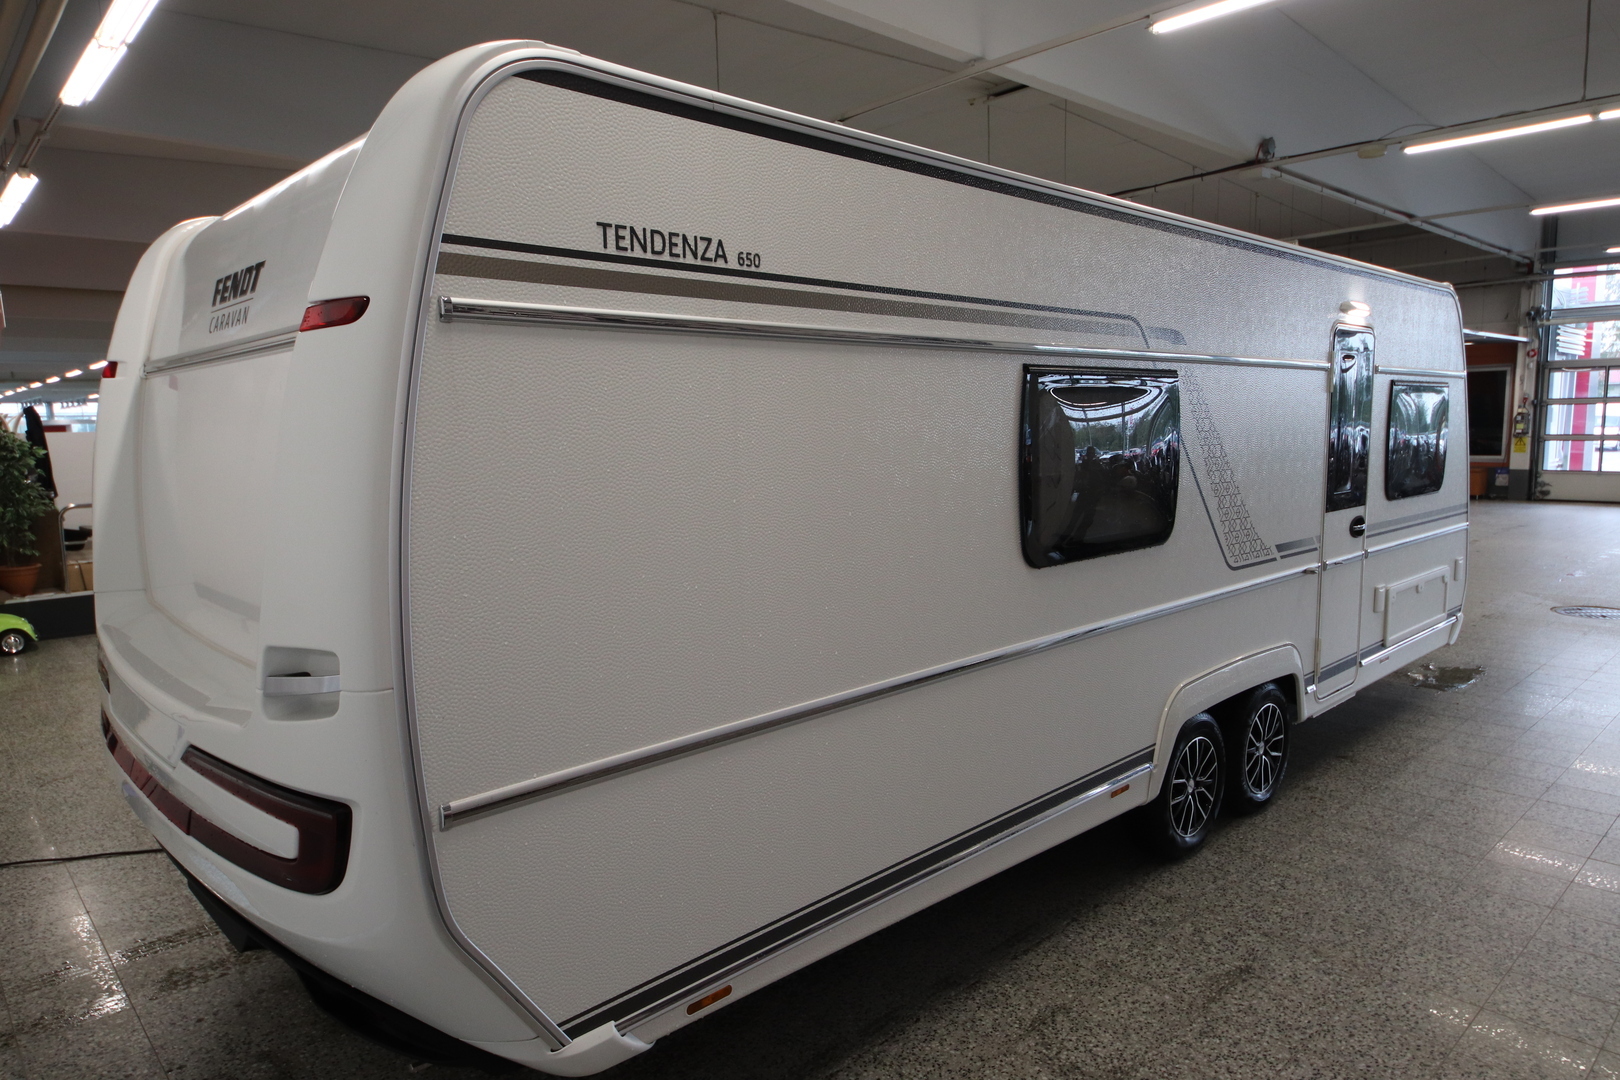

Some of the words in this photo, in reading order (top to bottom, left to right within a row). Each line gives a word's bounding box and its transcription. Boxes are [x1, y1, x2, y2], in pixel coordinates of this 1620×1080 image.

[596, 222, 728, 264] TENDENZA
[737, 252, 761, 268] 650
[212, 260, 267, 307] FENDT
[209, 306, 250, 334] CARAVAN
